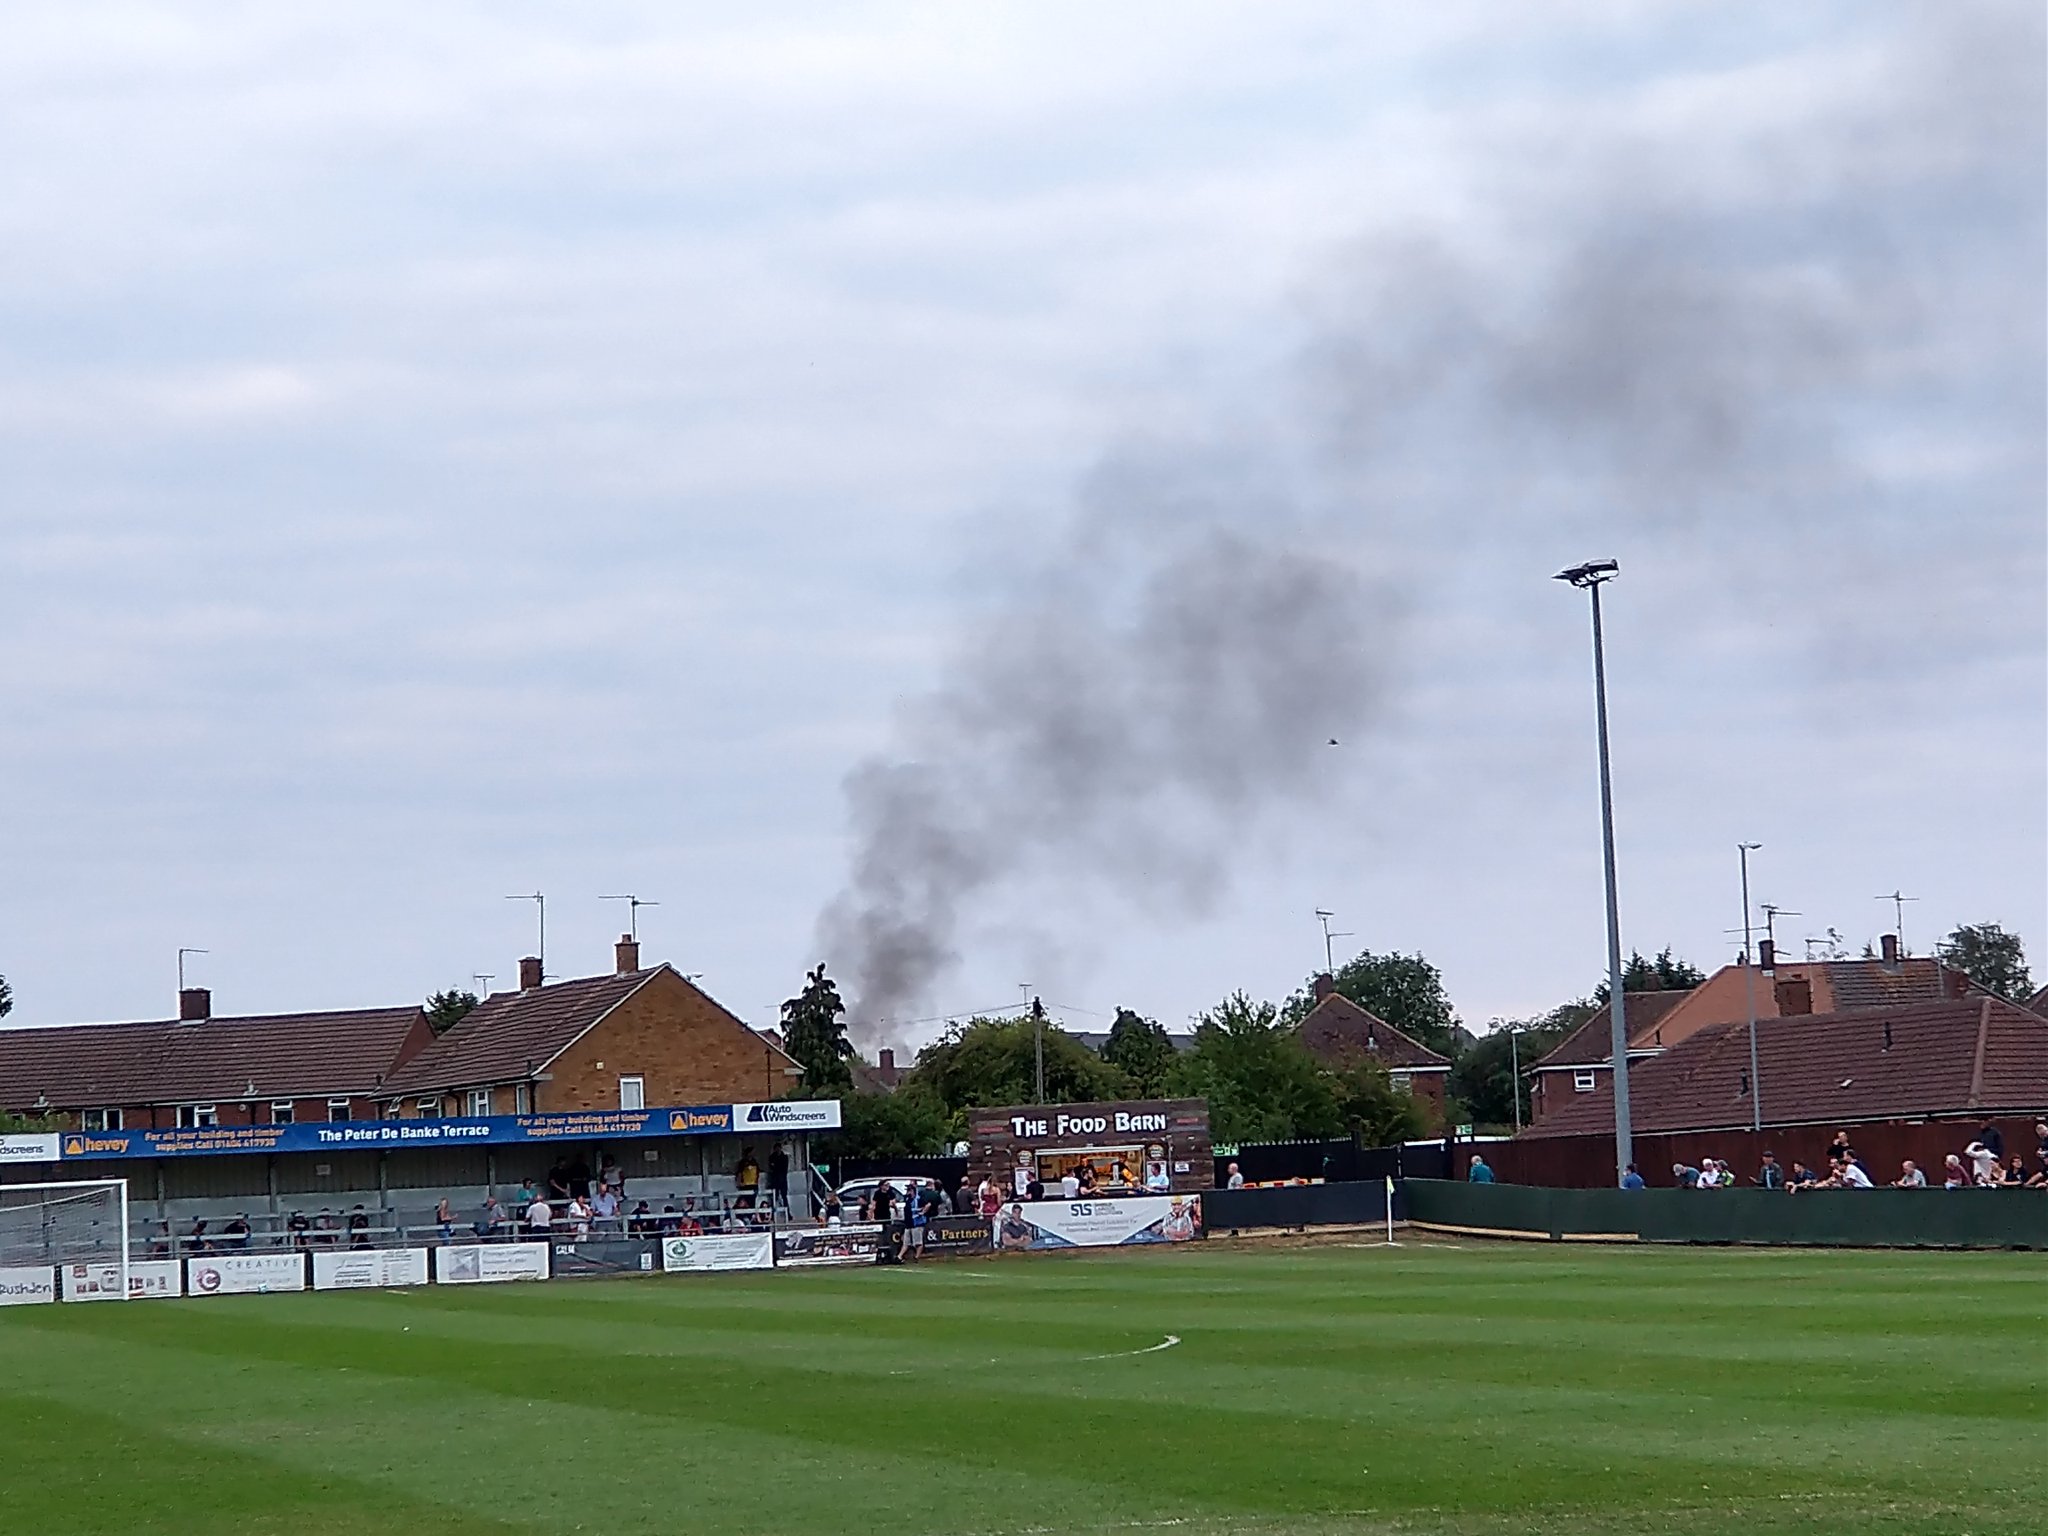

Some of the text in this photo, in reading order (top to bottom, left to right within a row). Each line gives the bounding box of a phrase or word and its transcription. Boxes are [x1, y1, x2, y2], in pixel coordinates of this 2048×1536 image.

[769, 1104, 792, 1114] Auto
[517, 1118, 532, 1126] For
[534, 1117, 545, 1125] all
[547, 1117, 566, 1126] your
[604, 1114, 620, 1122] and
[689, 1112, 729, 1128] hevey
[769, 1111, 826, 1123] Windscreens
[145, 1132, 161, 1141] For
[176, 1131, 197, 1141] your
[318, 1124, 490, 1142] The Peter De Banke Terrace
[527, 1126, 563, 1136] supplies
[564, 1125, 581, 1134] Call
[85, 1137, 129, 1153] hevey
[195, 1140, 214, 1149] Call
[1070, 1203, 1092, 1217] SLS
[927, 1228, 989, 1241] & Partners
[225, 1258, 298, 1270] CREATIVE
[0, 1282, 52, 1295] Rushden
